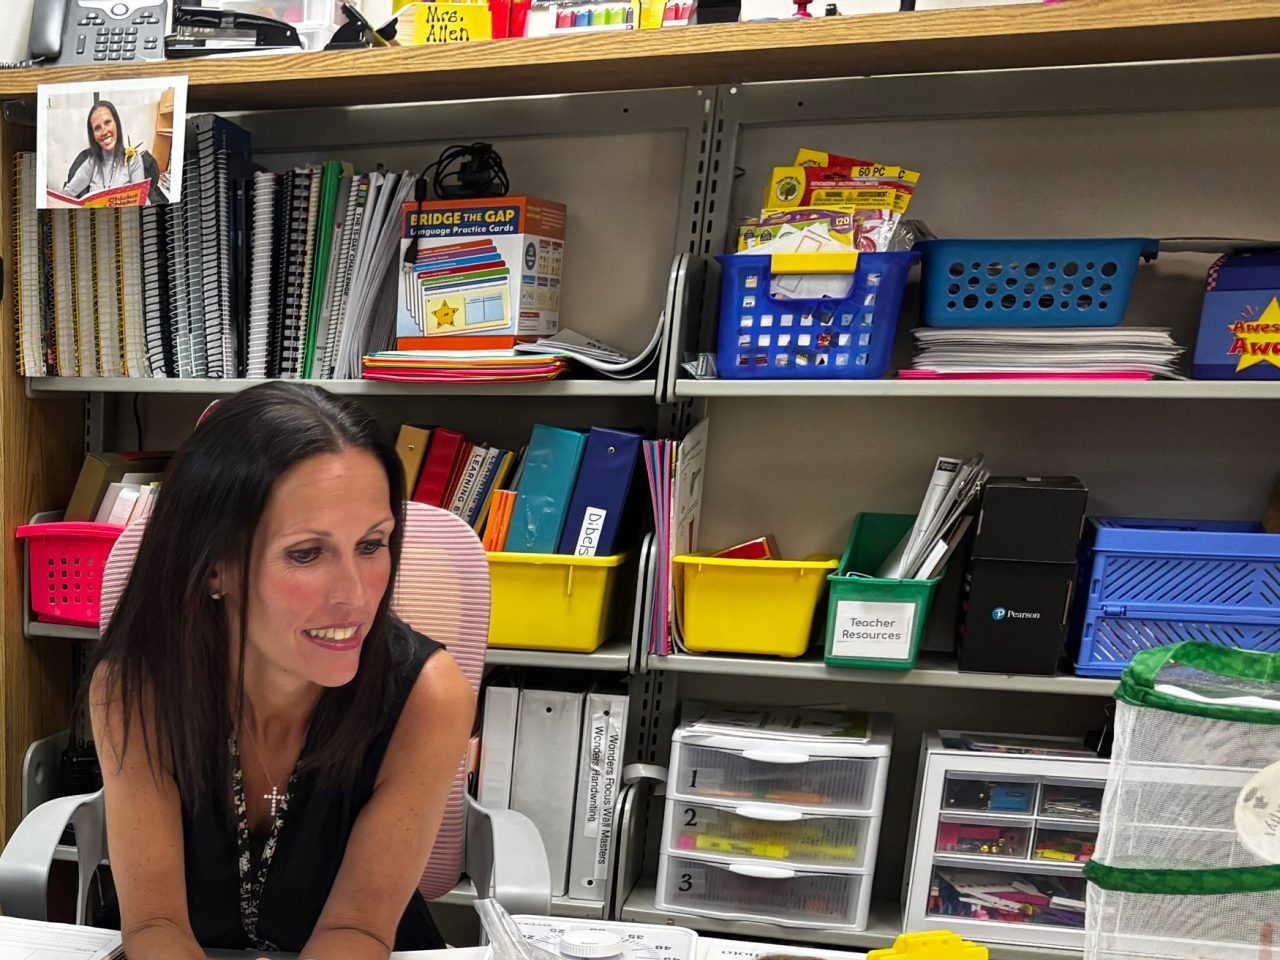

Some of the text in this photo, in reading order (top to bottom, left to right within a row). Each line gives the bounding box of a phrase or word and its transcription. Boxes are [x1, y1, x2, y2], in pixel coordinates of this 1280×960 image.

[425, 5, 464, 25] Mrs.
[425, 24, 470, 44] Allen
[858, 167, 885, 177] 60 PC
[411, 211, 461, 226] BRIDGE
[464, 213, 482, 222] THE
[484, 209, 515, 223] GAP
[835, 216, 849, 226] 120
[410, 224, 514, 237] Lnguage Practice Cards
[343, 254, 356, 297] CHALLENGE
[457, 453, 482, 502] LEARNING
[578, 512, 602, 556] Dibels
[850, 617, 896, 628] Teacher
[1007, 609, 1040, 620] Pearson
[842, 629, 901, 641] Resources
[587, 726, 604, 822] Wonders Handwriting
[689, 769, 697, 788] 1
[597, 734, 619, 865] Wonders Focus Wall Masters
[684, 808, 698, 827] 2
[678, 873, 693, 892] 3
